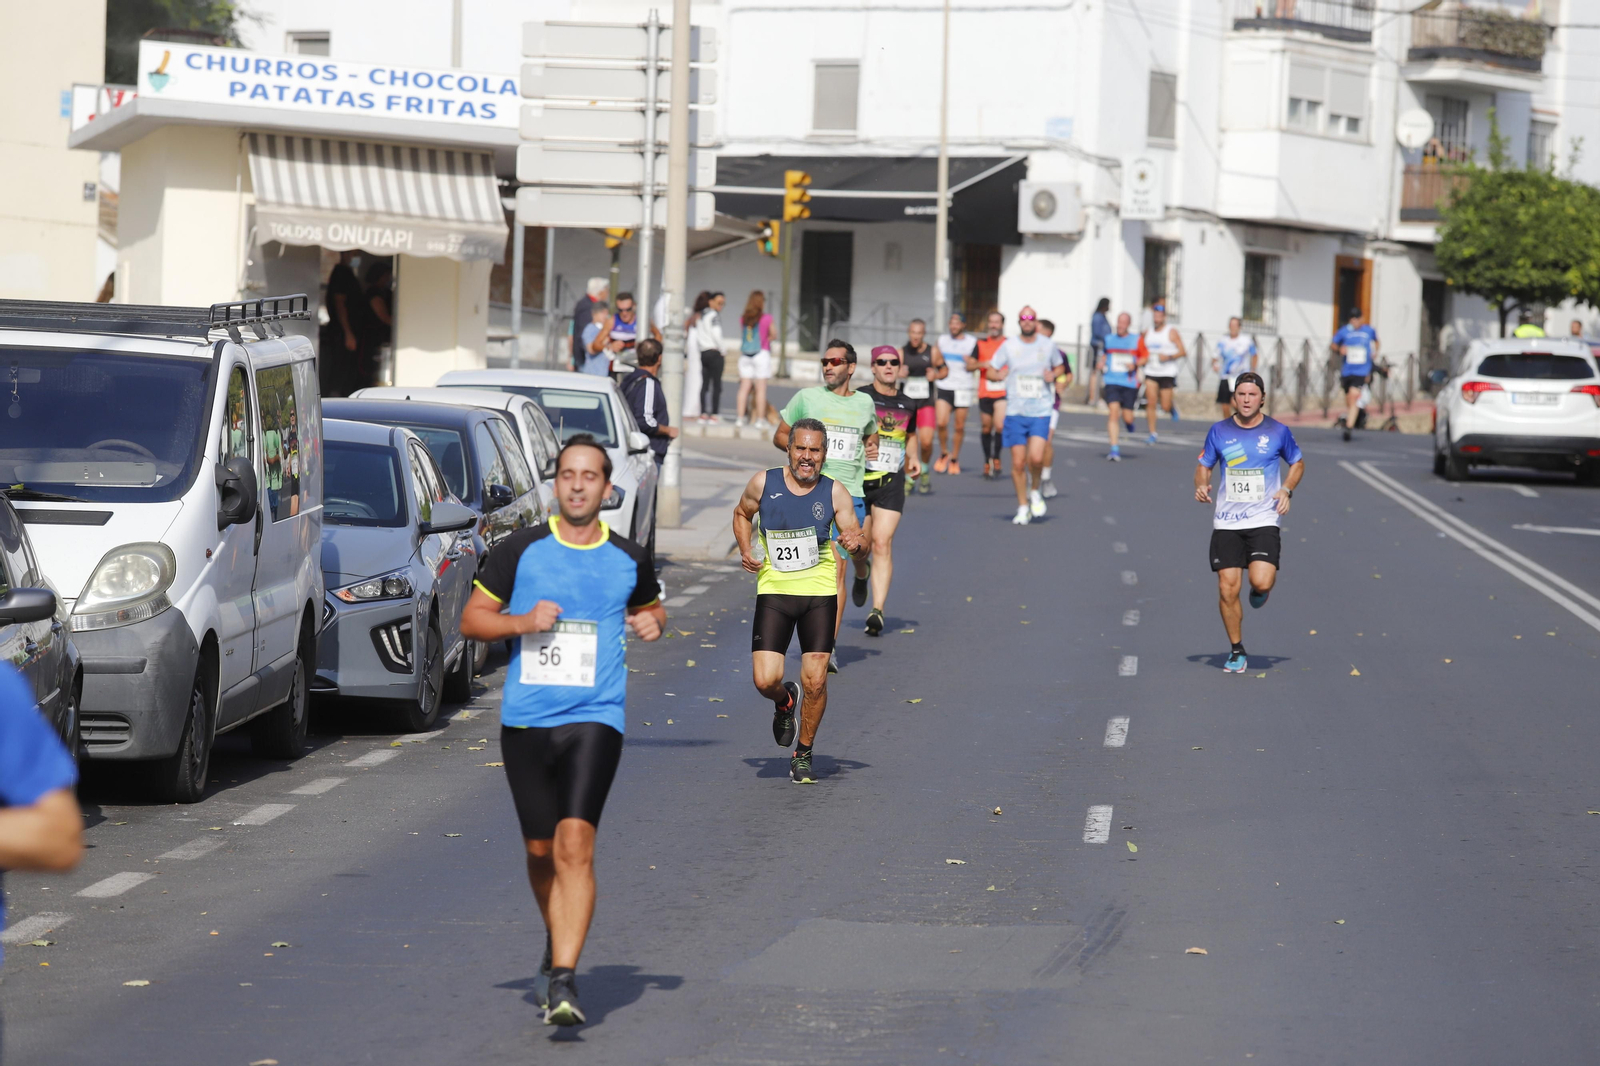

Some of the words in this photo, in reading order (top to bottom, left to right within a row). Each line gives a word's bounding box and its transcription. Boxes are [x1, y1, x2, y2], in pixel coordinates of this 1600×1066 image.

[185, 52, 338, 81] CHURROS
[369, 67, 518, 96] CHOCOLA
[228, 82, 375, 109] PATATAS
[386, 95, 498, 120] FRITAS
[270, 221, 324, 241] TOLDOS
[327, 223, 414, 250] ONUTAPI
[1232, 482, 1250, 493] 134
[795, 529, 813, 537] HUELVA
[776, 546, 800, 560] 231
[539, 645, 561, 666] 56
